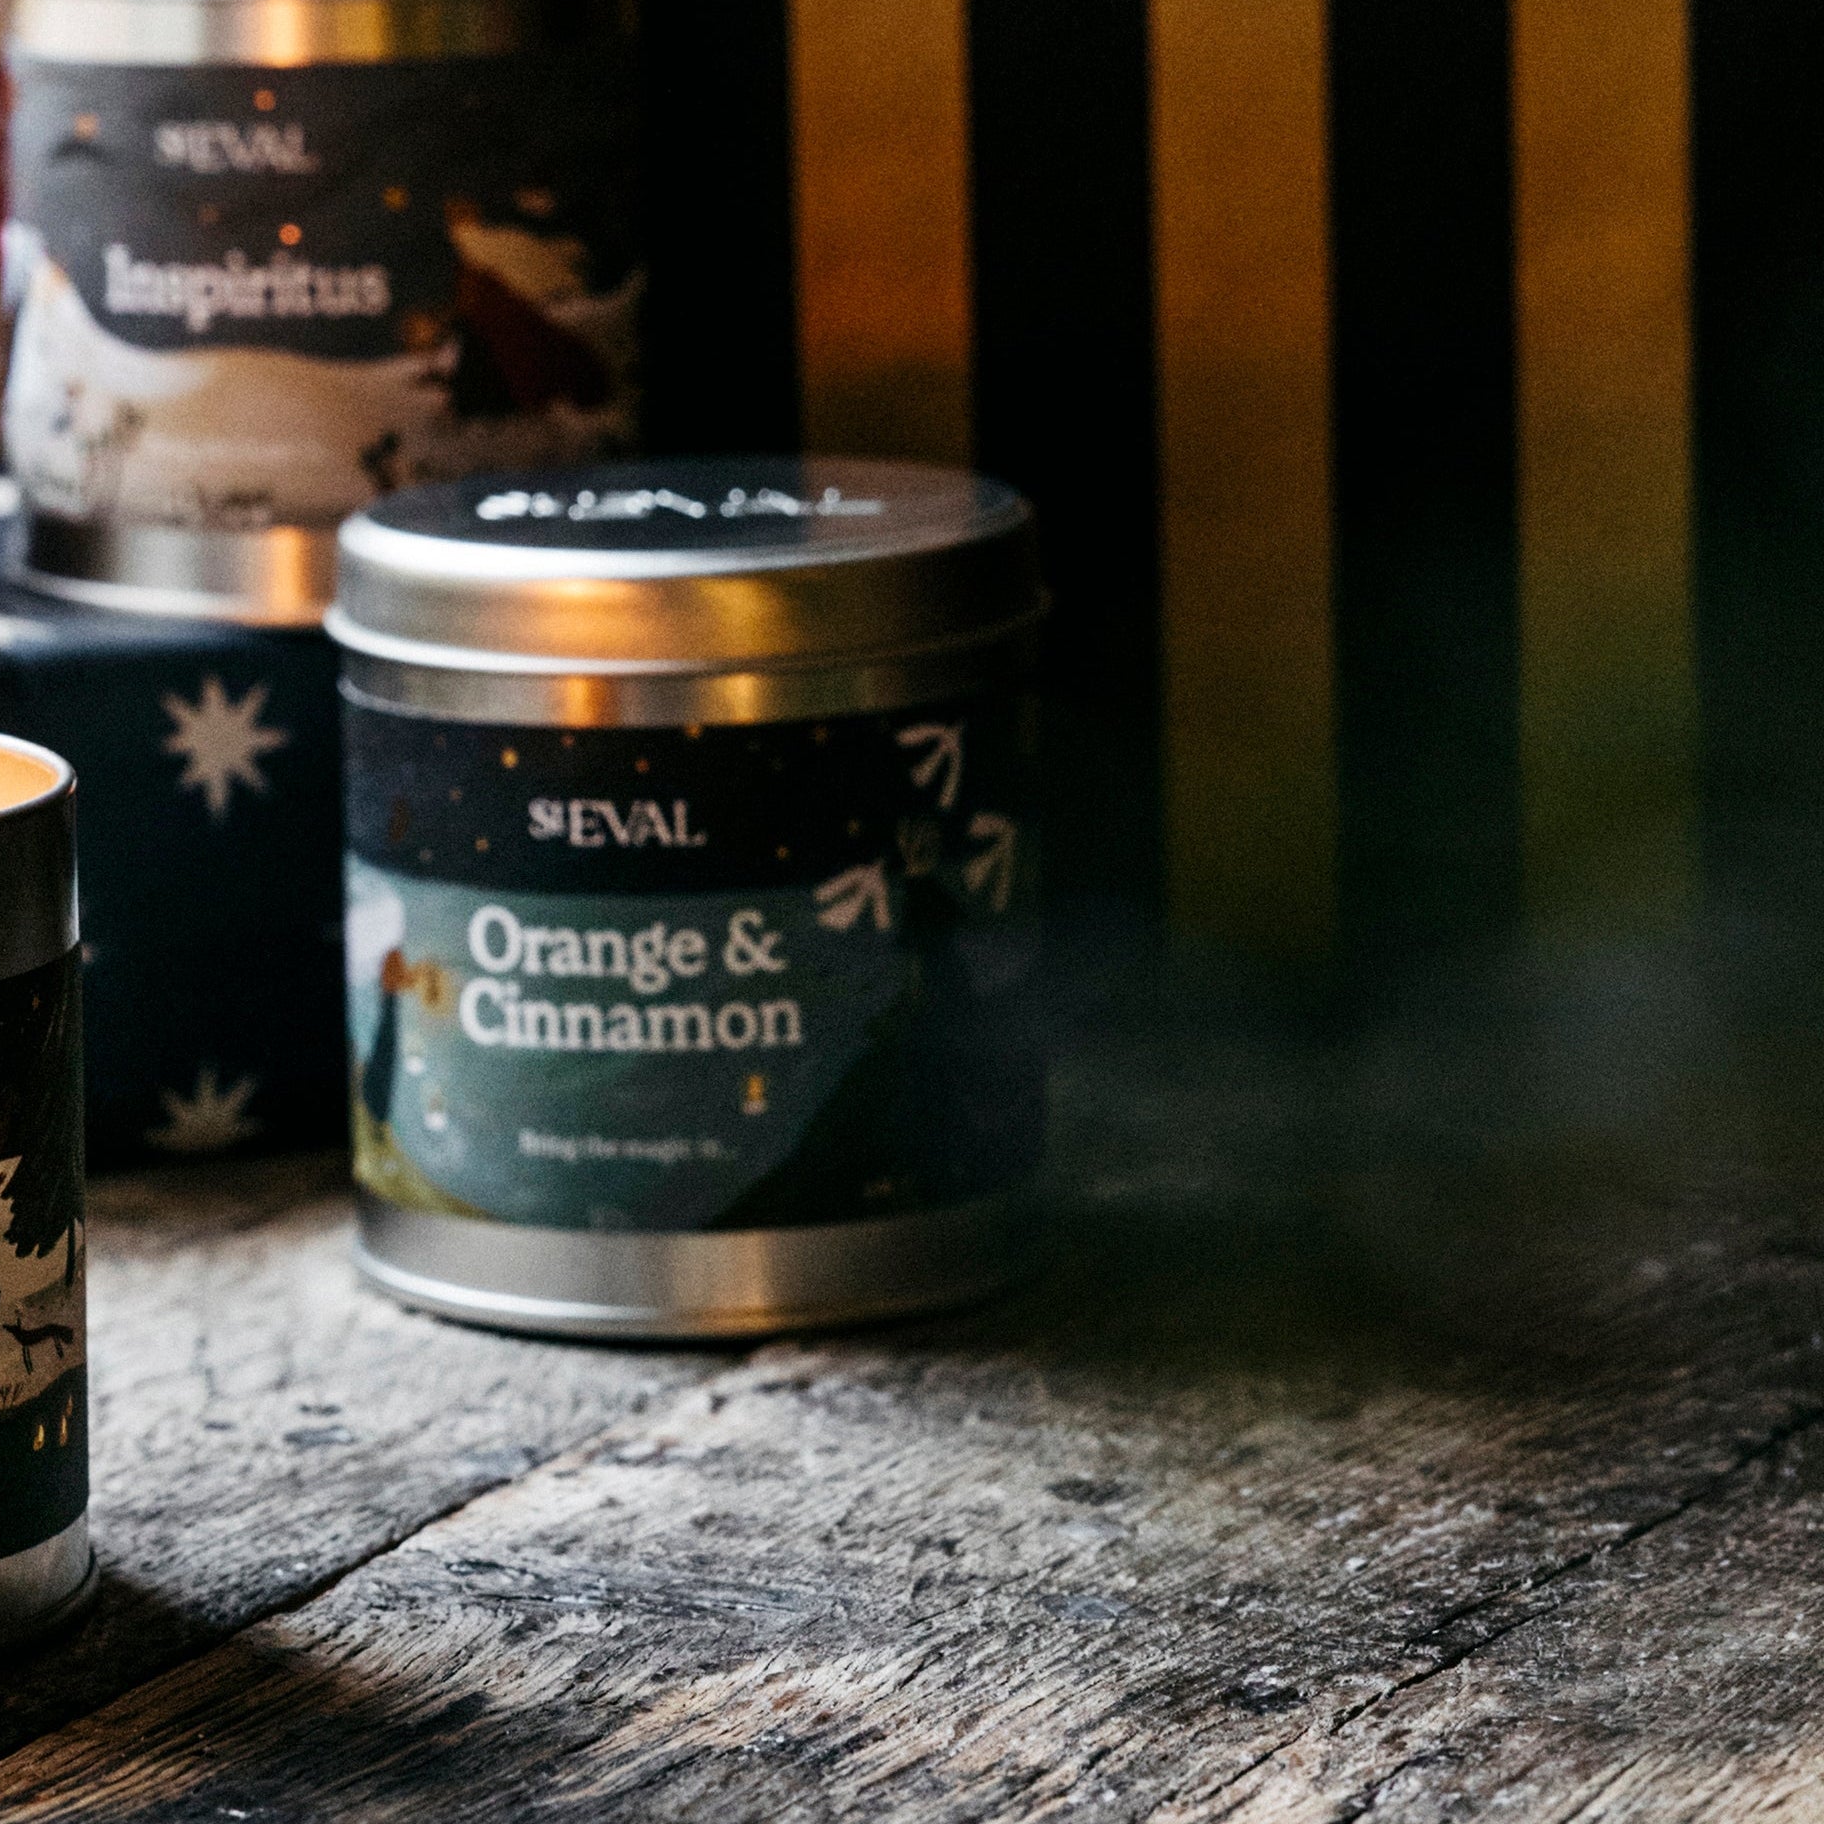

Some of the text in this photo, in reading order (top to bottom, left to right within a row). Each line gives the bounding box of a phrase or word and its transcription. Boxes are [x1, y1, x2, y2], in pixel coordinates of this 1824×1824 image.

[103, 241, 392, 332] Inspiritus
[468, 904, 790, 995] Orange &
[458, 976, 803, 1052] Cinnamon
